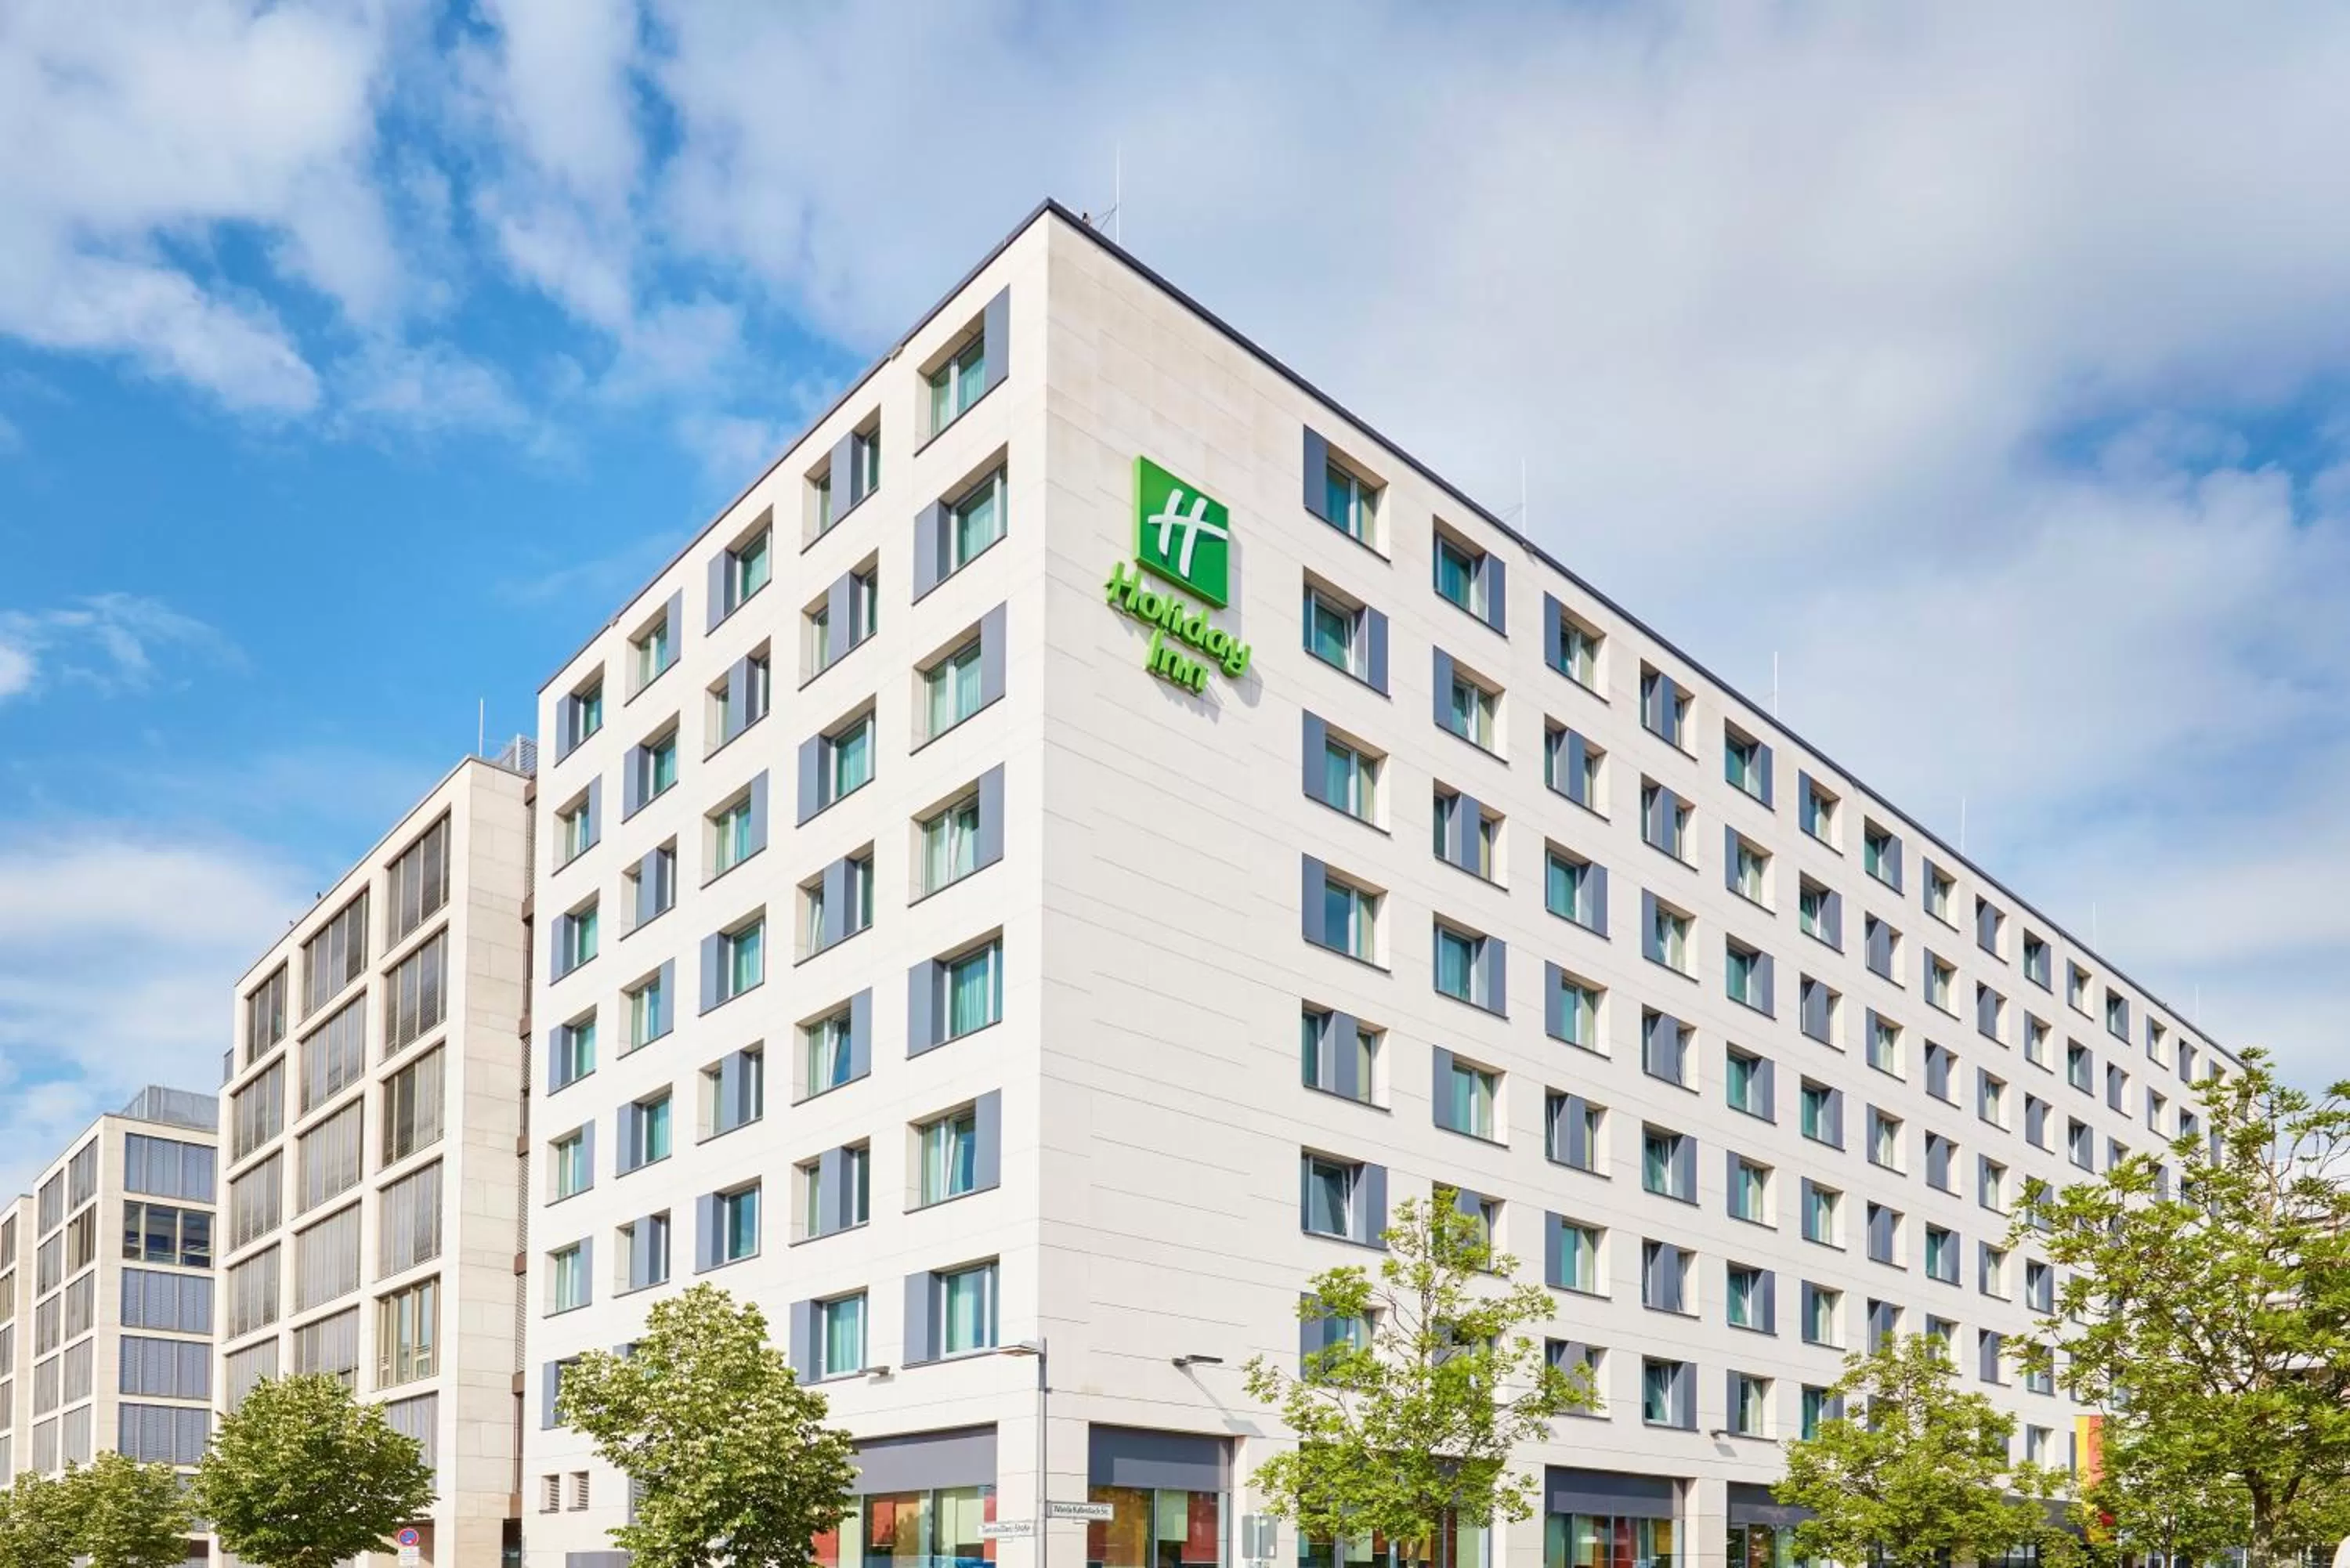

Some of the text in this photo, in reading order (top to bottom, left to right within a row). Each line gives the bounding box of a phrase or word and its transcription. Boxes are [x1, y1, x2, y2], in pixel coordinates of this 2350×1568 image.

[1148, 488, 1228, 578] H
[1104, 562, 1252, 678] Holiday
[1144, 629, 1209, 695] Inn
